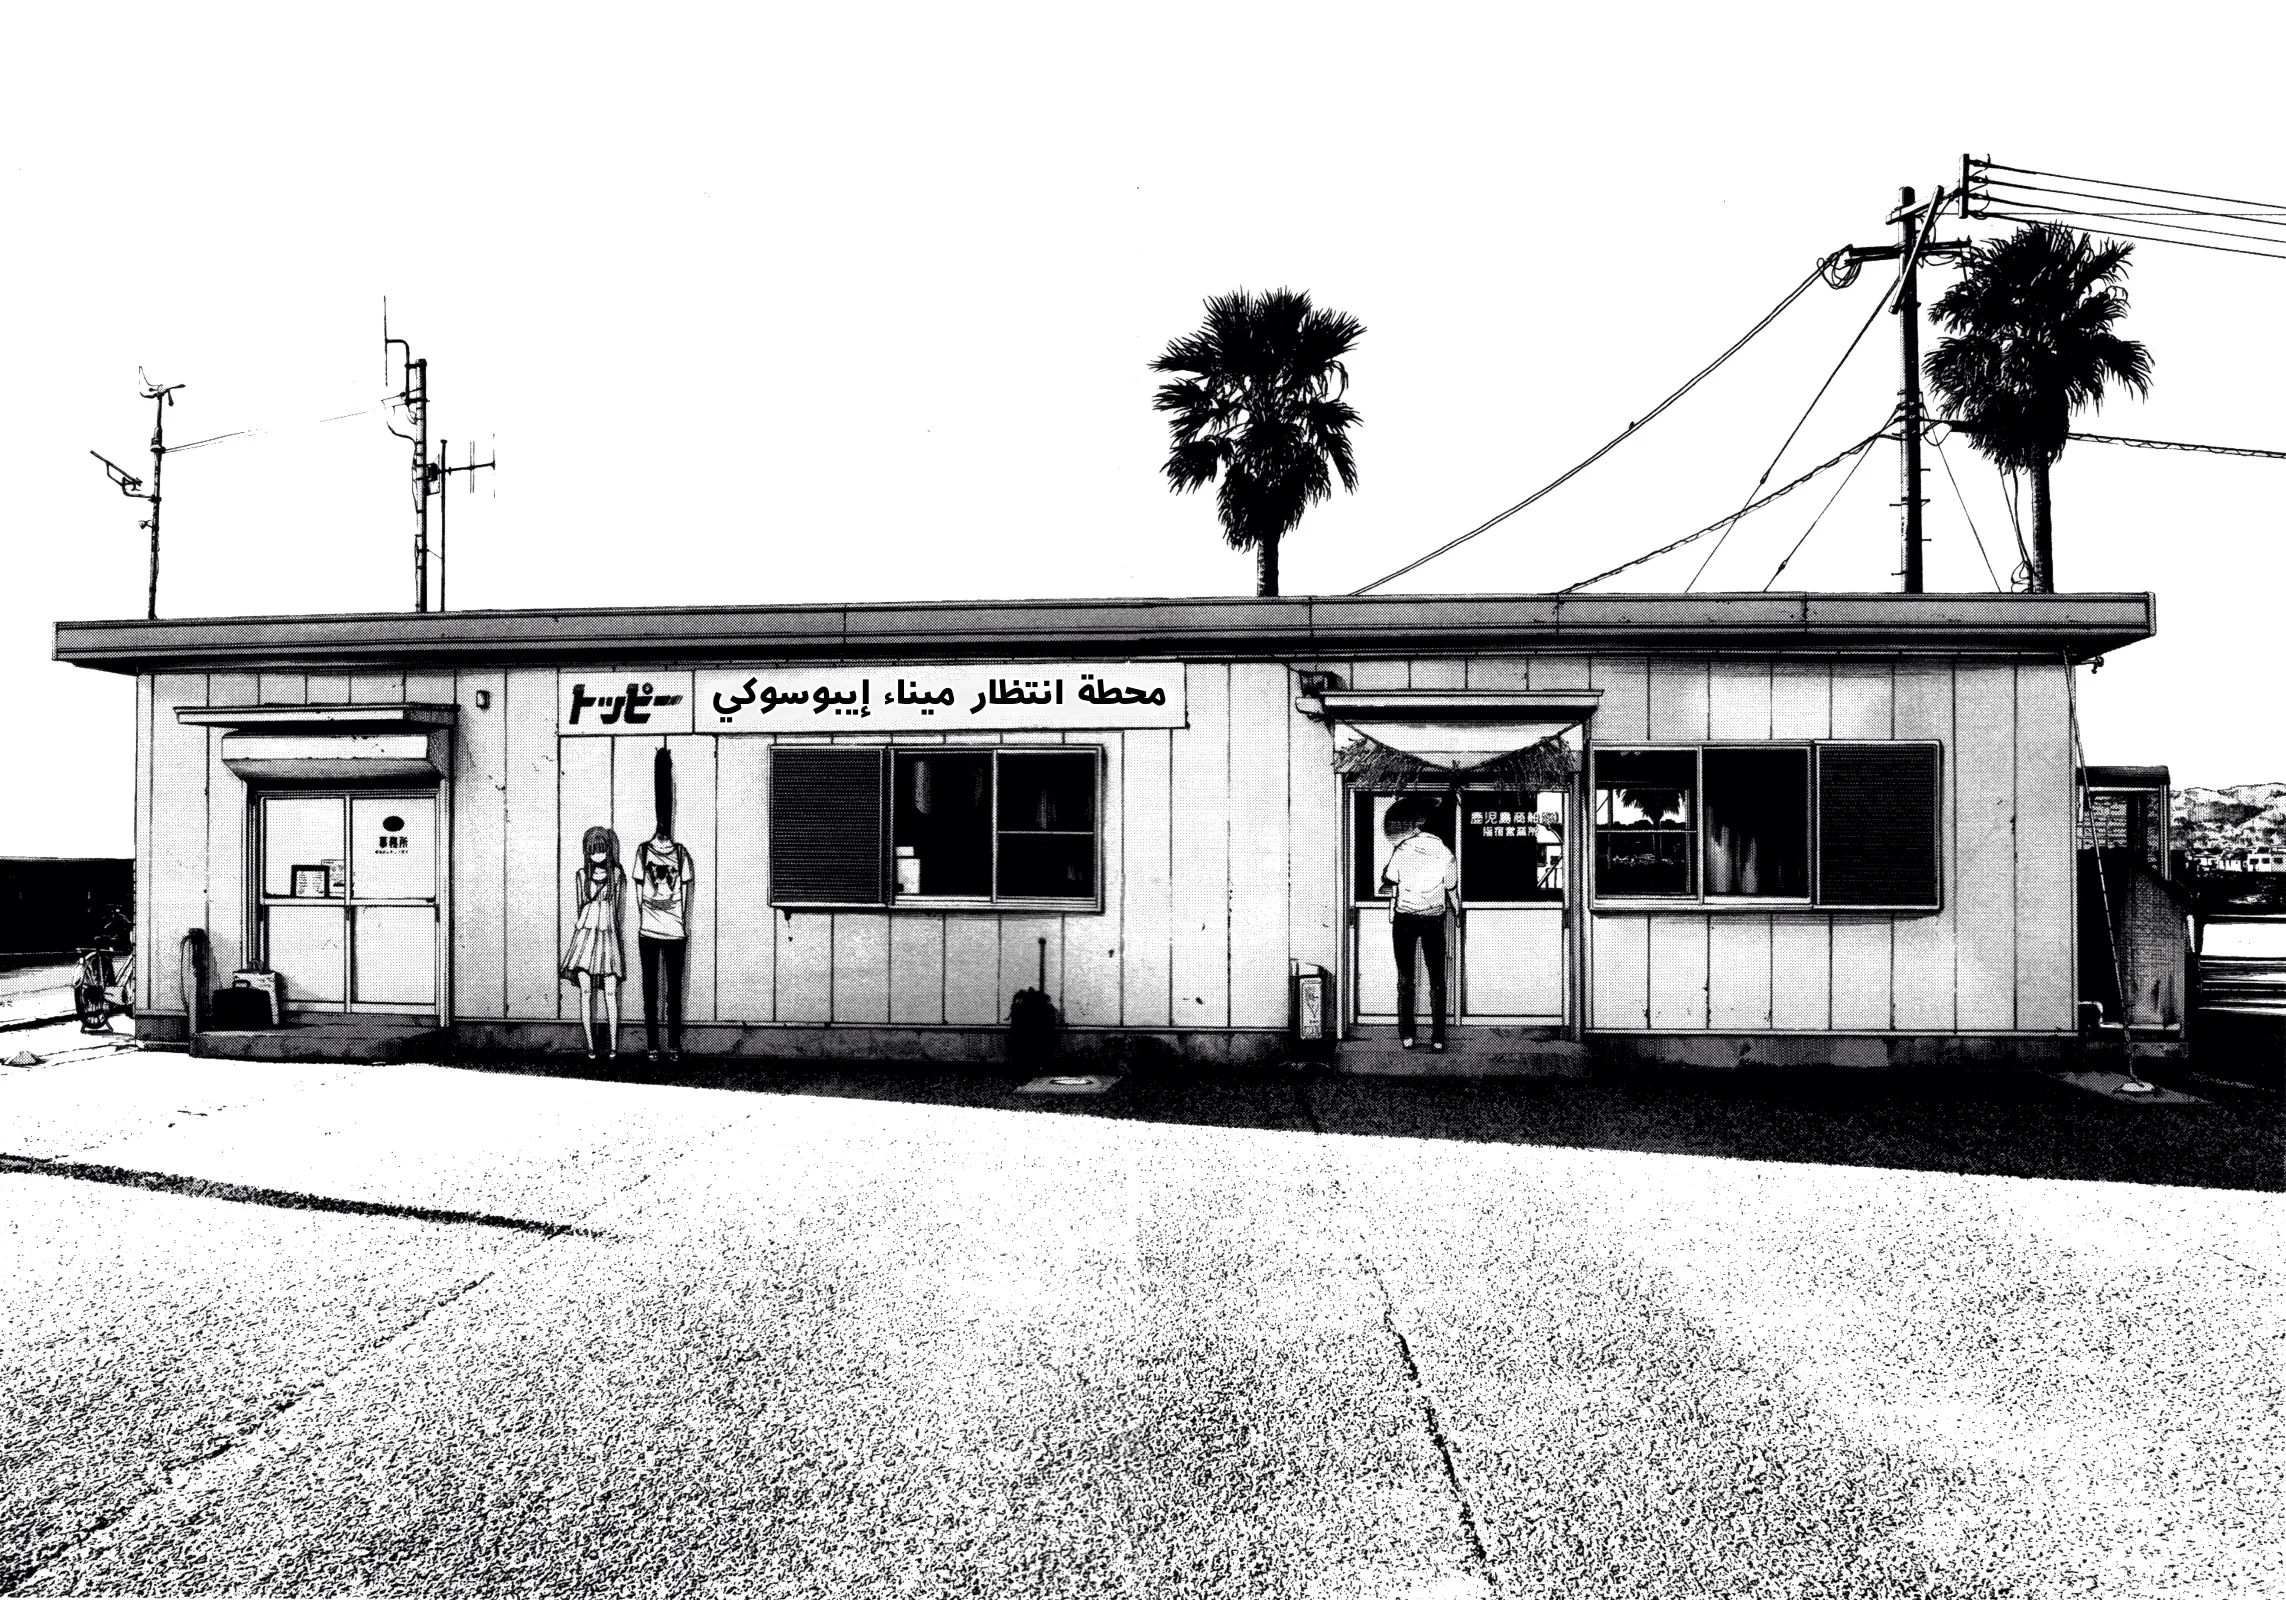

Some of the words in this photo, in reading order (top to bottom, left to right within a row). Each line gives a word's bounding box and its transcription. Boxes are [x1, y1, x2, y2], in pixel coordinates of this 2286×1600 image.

[569, 682, 684, 725] トッピー
[712, 676, 871, 723] إيبوسوكي
[884, 679, 955, 716] ميناء
[969, 678, 1063, 715] انتظار
[1078, 674, 1166, 706] محطة
